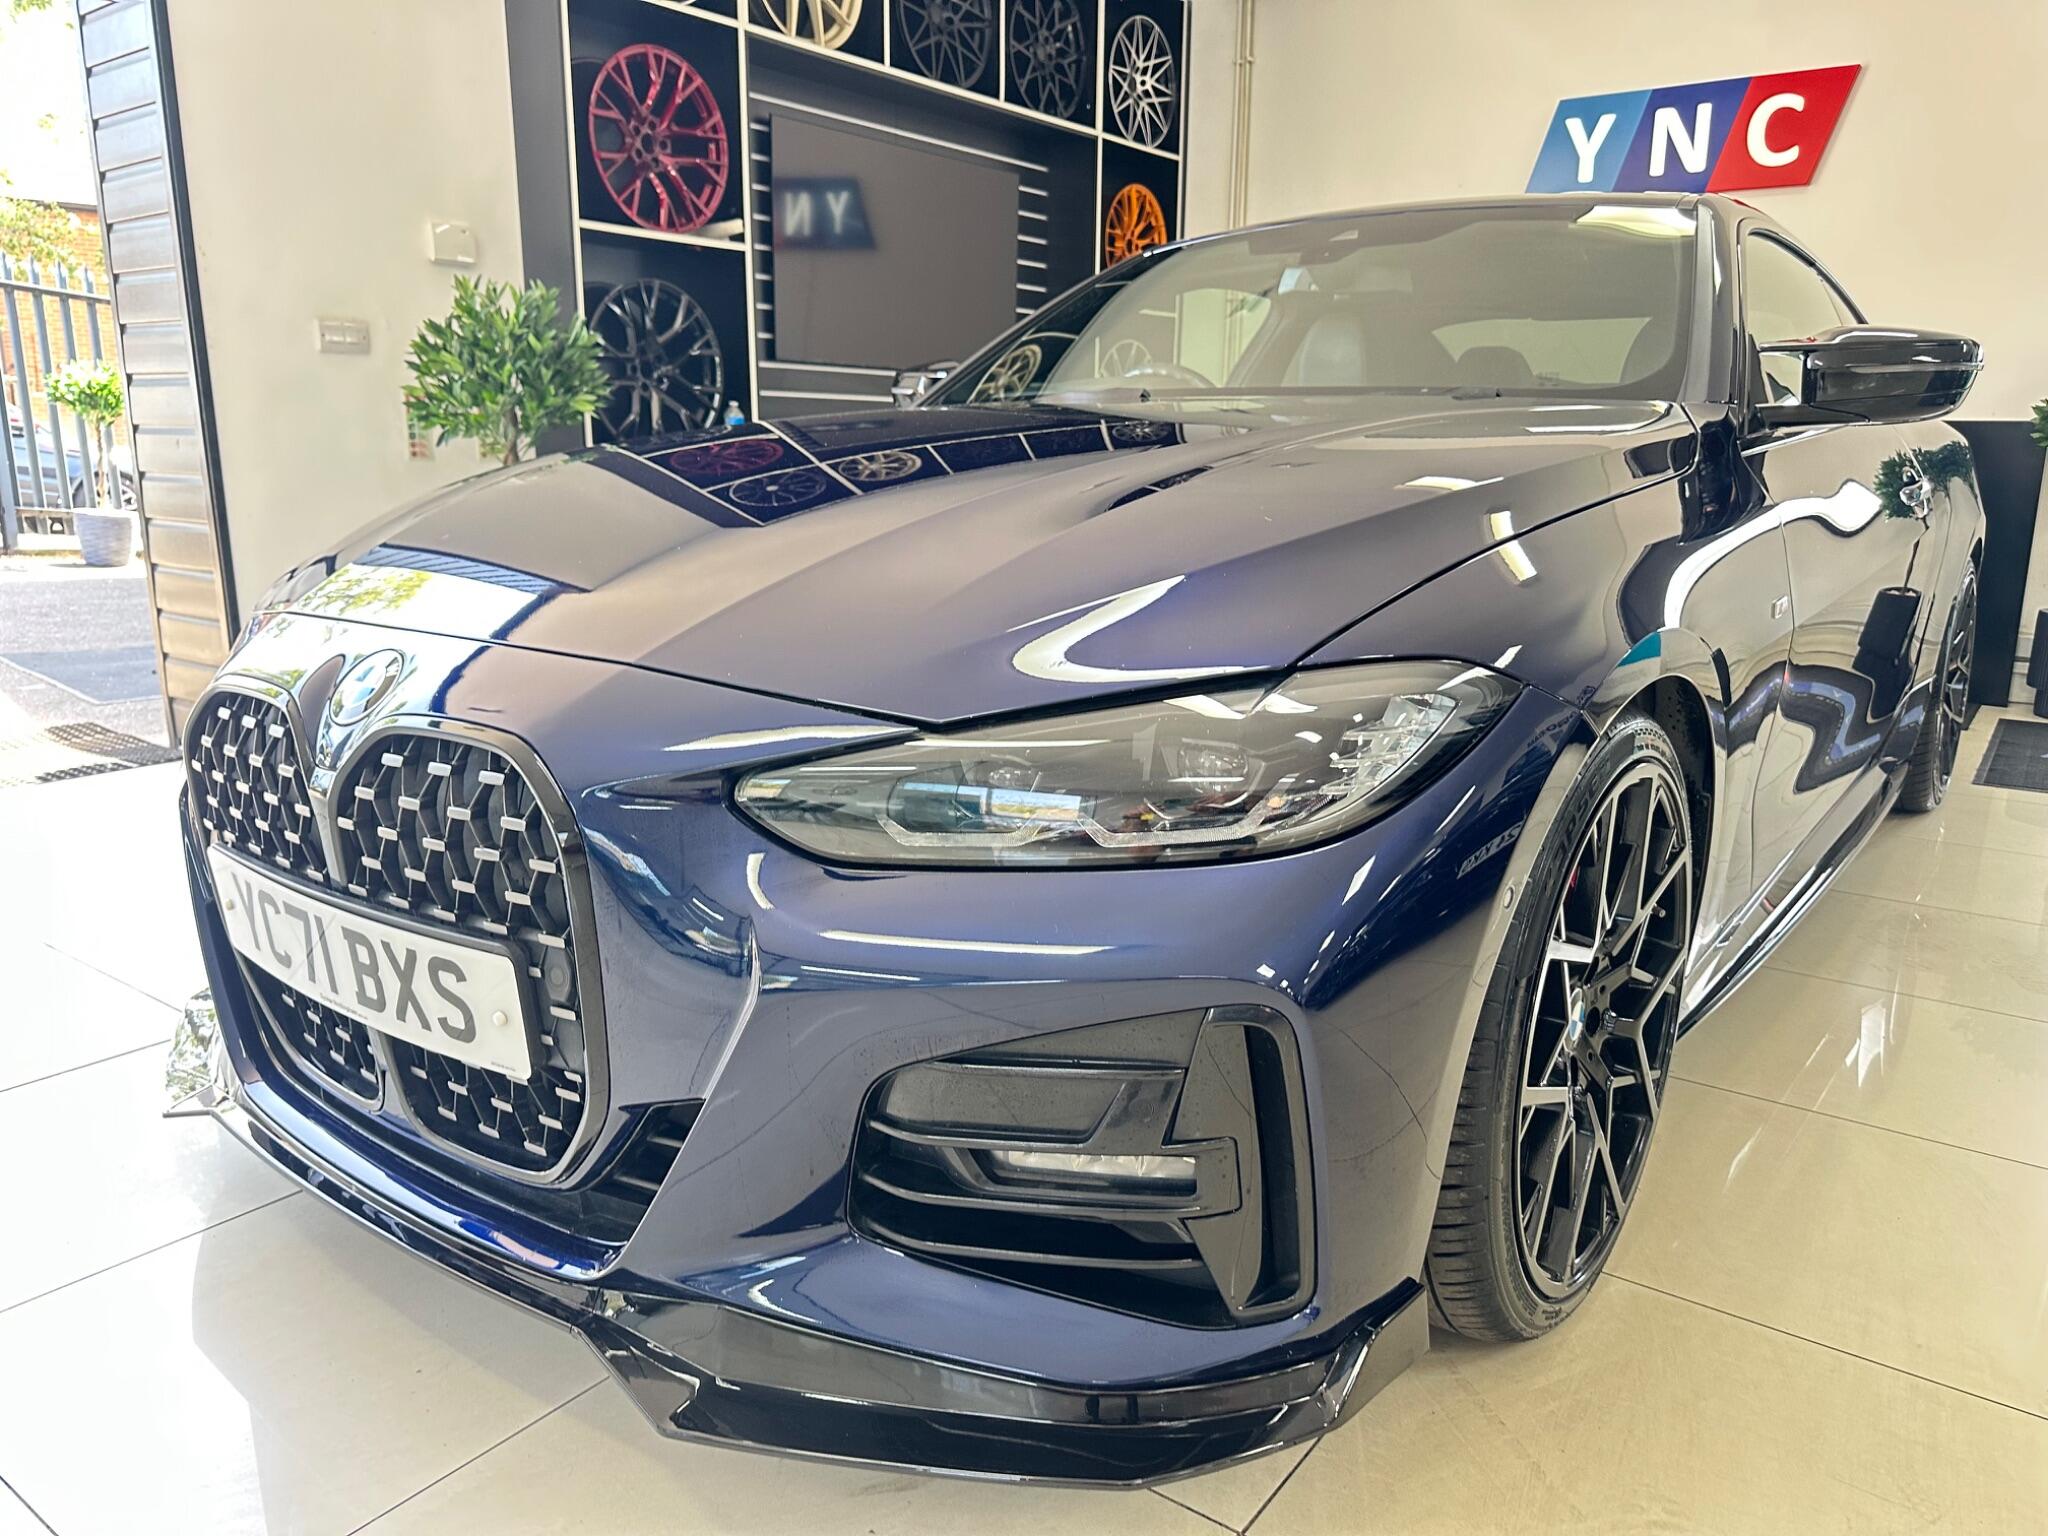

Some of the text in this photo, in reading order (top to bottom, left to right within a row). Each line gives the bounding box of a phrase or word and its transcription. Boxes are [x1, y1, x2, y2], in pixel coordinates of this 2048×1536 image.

[1565, 93, 1805, 183] YNC
[231, 872, 477, 1044] YC71 BXS
